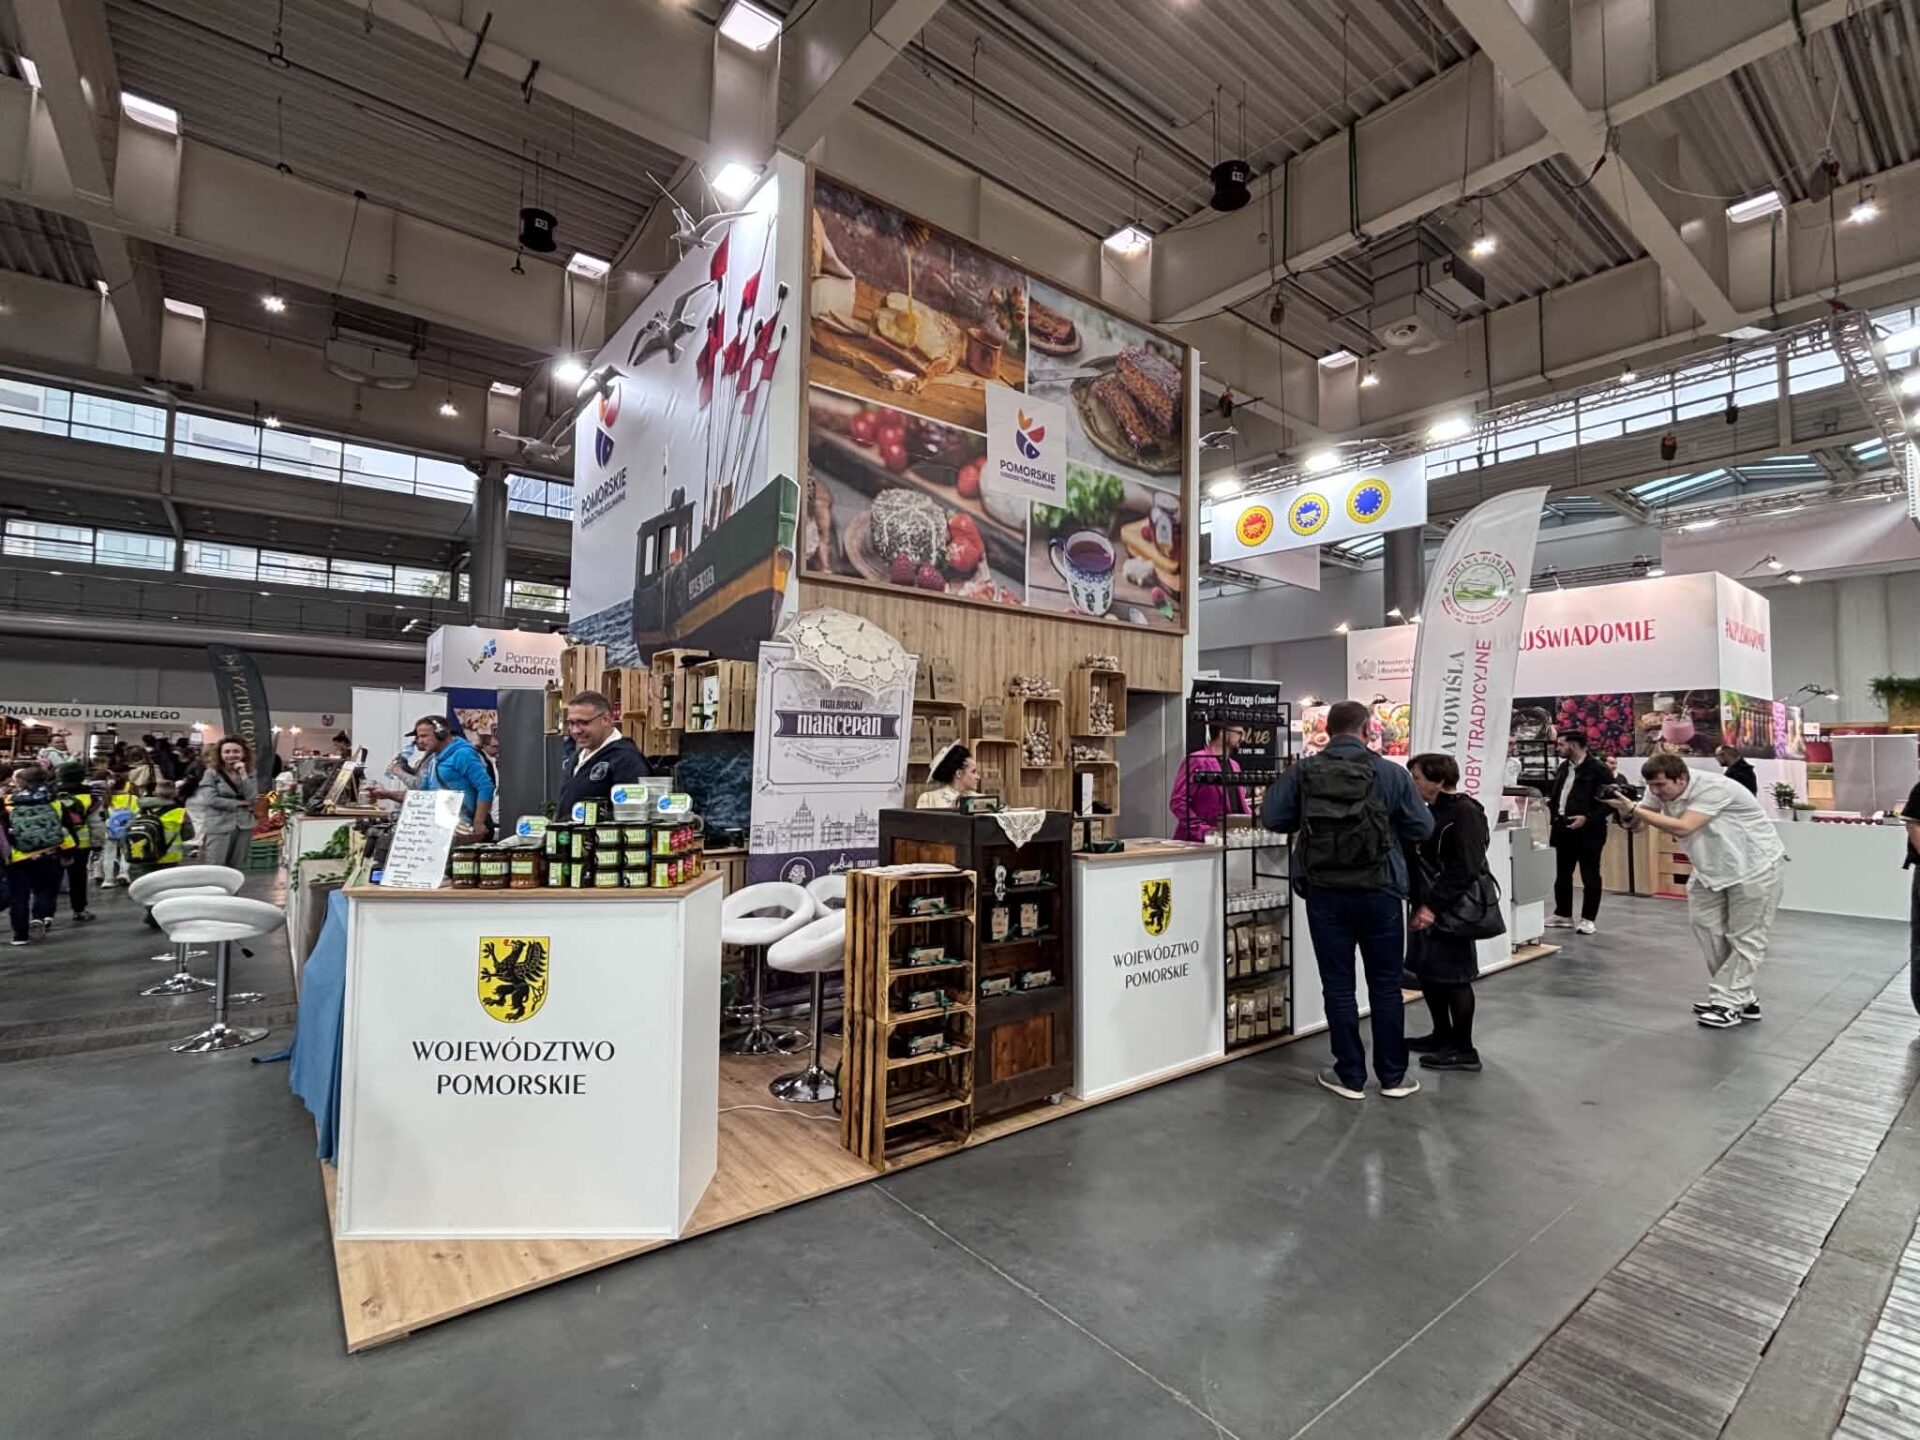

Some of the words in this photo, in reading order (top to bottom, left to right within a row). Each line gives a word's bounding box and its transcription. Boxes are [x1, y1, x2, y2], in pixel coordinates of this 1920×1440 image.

[1000, 459, 1056, 485] POMORSKIE
[581, 466, 627, 517] POMORSKIE
[494, 662, 555, 676] Zachodnie
[505, 651, 558, 666] Pomorze
[1442, 651, 1465, 737] POWIŚLA
[1467, 640, 1491, 750] TRADYCYJNE
[86, 709, 89, 717] I
[94, 709, 180, 720] LOKALNEGO
[1113, 940, 1199, 968] WOJEWÓDZTWO
[1125, 962, 1190, 989] POMORSKIE
[412, 1036, 615, 1062] WOJEWÓDZTWO
[437, 1074, 586, 1095] POMORSKIE
